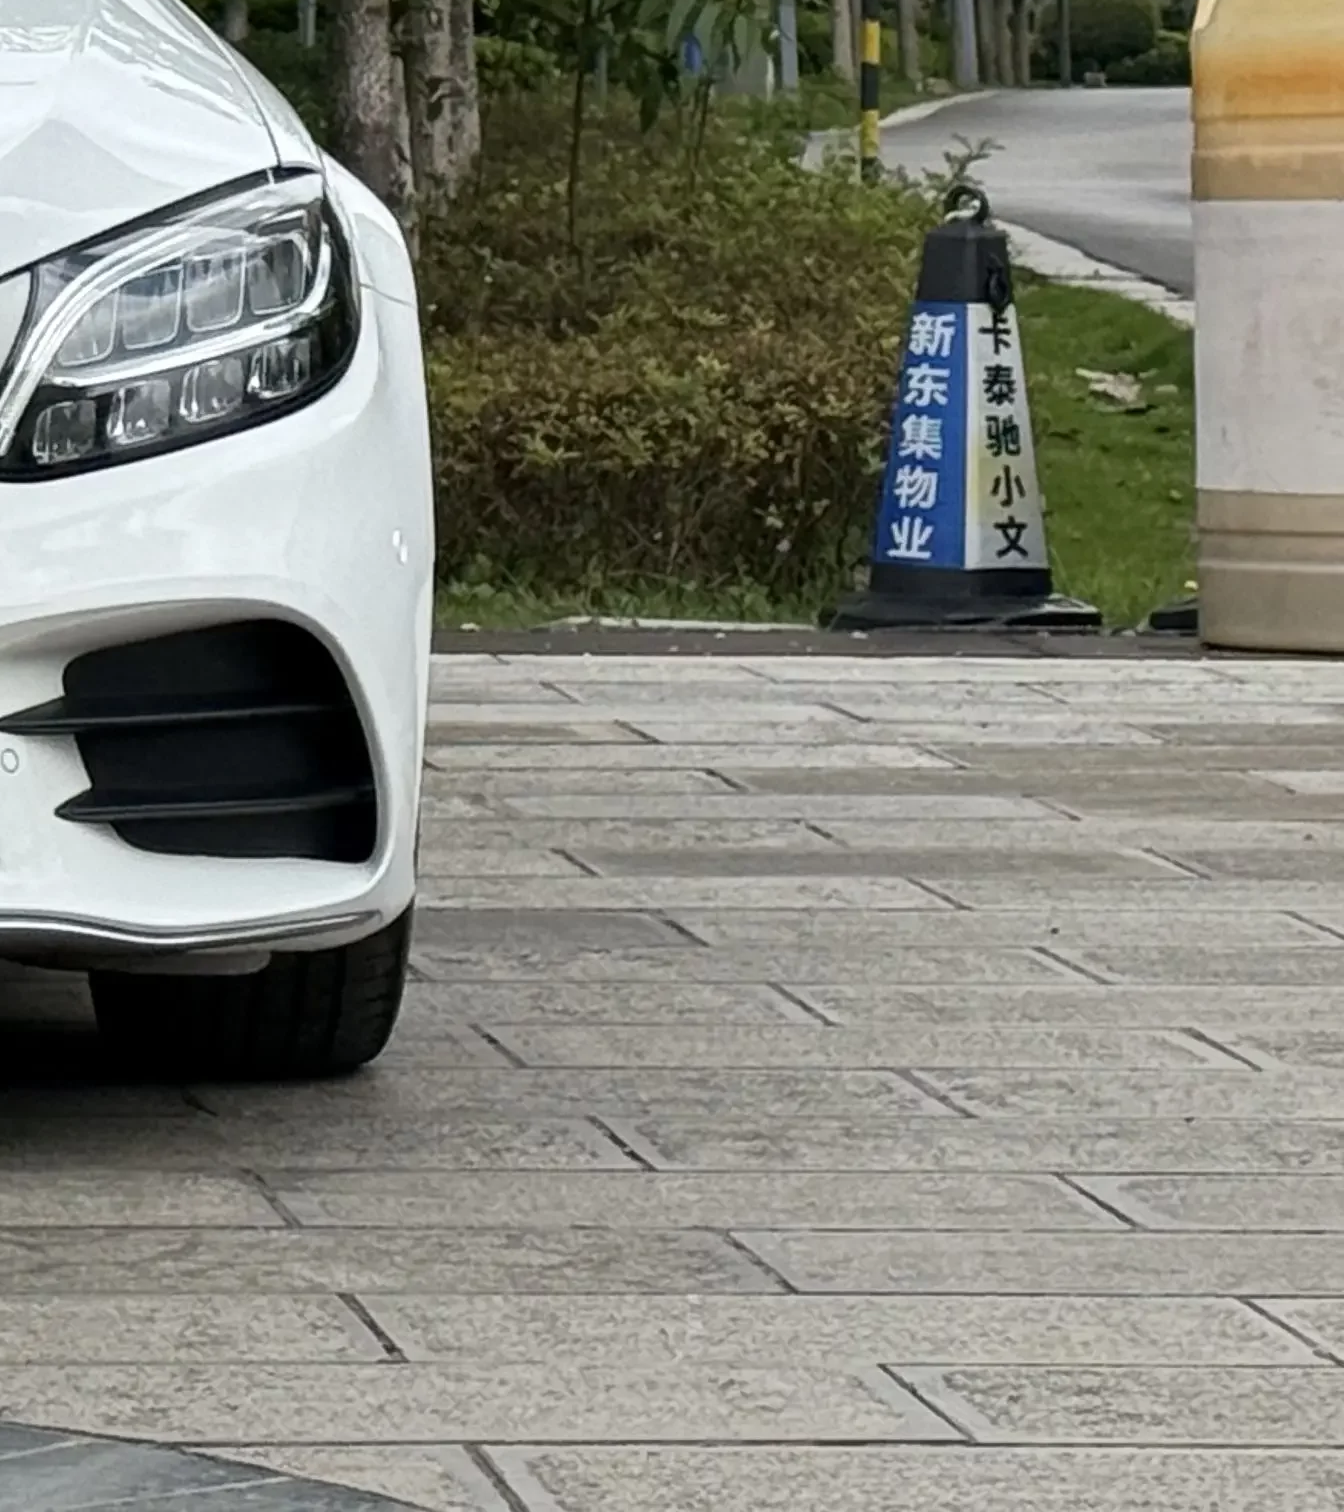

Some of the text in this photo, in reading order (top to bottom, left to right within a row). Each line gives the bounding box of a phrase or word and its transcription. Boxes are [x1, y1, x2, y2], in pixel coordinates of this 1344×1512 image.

[886, 311, 957, 560] 新东集物业
[978, 310, 1030, 559] 卡泰驰小文
